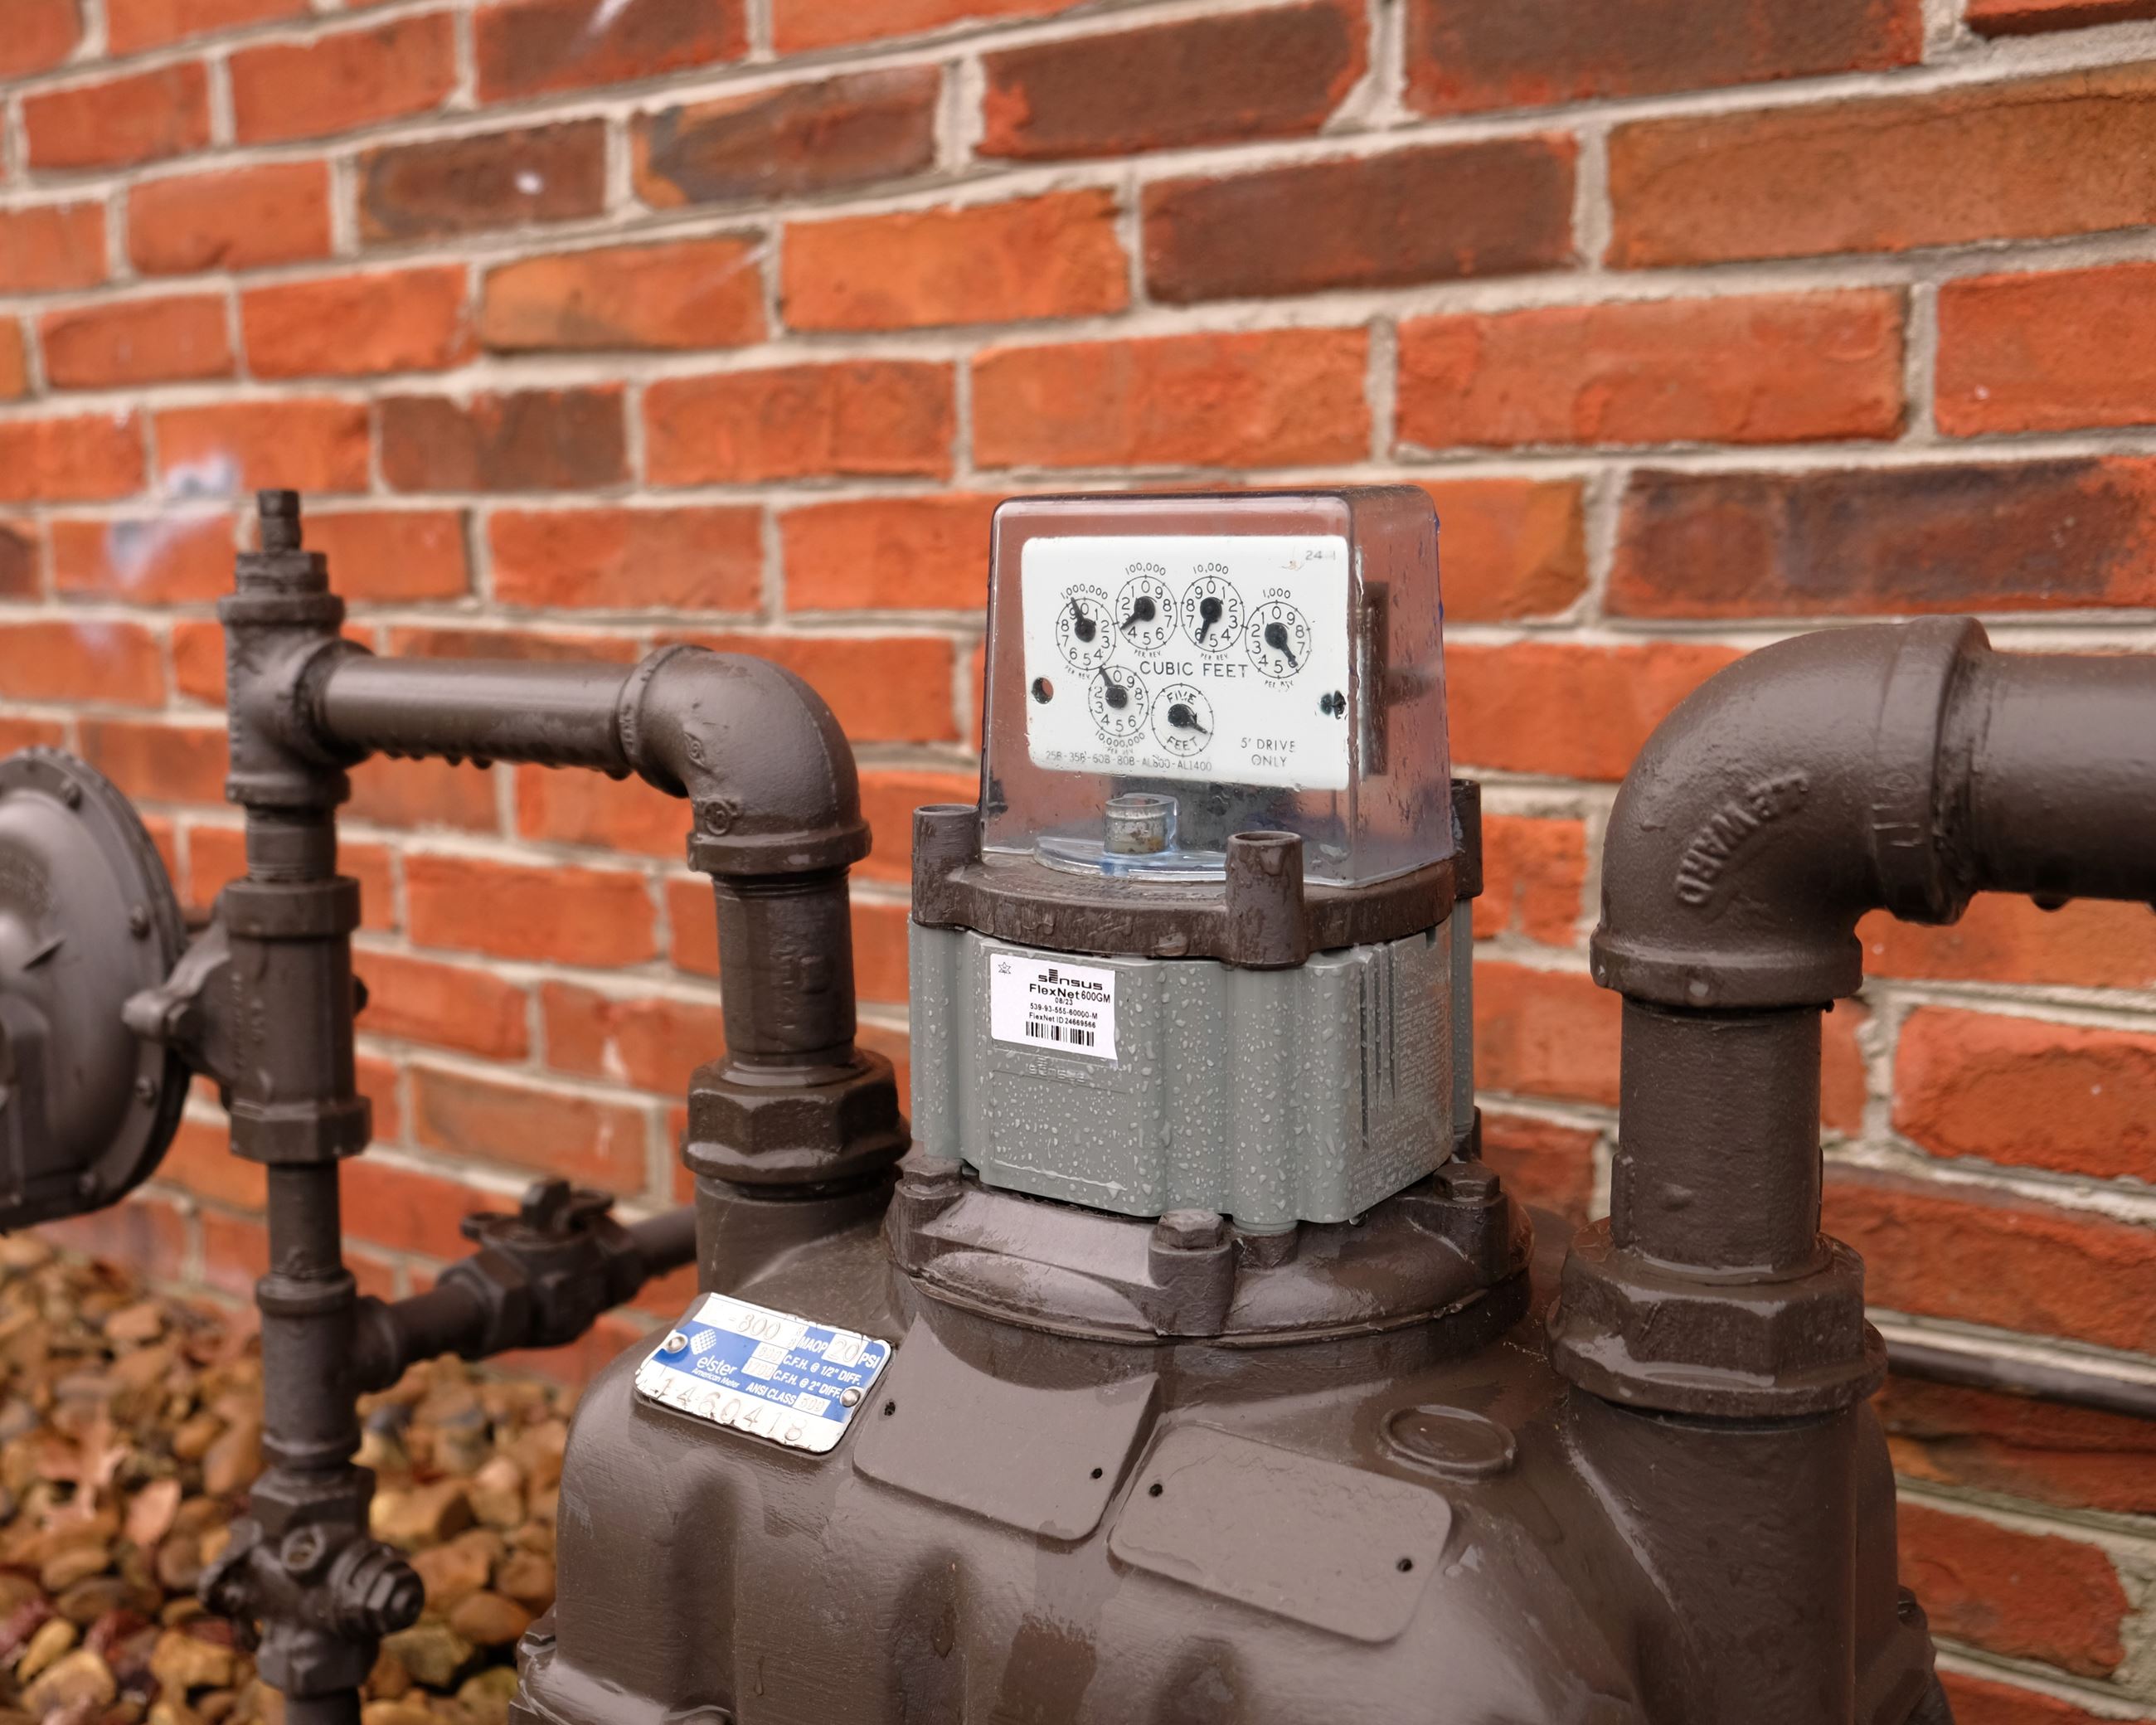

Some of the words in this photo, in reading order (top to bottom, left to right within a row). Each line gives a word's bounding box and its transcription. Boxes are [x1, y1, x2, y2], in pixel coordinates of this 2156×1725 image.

[1125, 562, 1166, 576] 100,000
[1192, 563, 1229, 575] 10,000
[1061, 583, 1108, 600] 1,000,000
[1141, 580, 1150, 593] 0
[1154, 586, 1163, 599] 9
[1195, 586, 1203, 599] 9
[1207, 581, 1216, 594] 0
[1263, 588, 1290, 599] 1,000
[1080, 603, 1089, 615] 0
[1122, 597, 1130, 610] 2
[1163, 599, 1172, 612] 8
[1186, 599, 1195, 612] 8
[1228, 599, 1238, 612] 2
[1272, 606, 1281, 620] 0
[1286, 612, 1295, 625] 9
[1061, 620, 1069, 632] 8
[1101, 620, 1110, 633] 2
[1164, 615, 1173, 628] 7
[1187, 615, 1194, 629] 7
[1228, 615, 1238, 629] 3
[1128, 626, 1138, 639] 4
[1156, 627, 1164, 640] 6
[1221, 629, 1231, 641] 4
[1251, 624, 1260, 637] 2
[1295, 624, 1304, 639] 8
[1061, 635, 1069, 647] 7
[1101, 636, 1110, 649] 3
[1143, 632, 1151, 645] 5
[1209, 634, 1218, 648] 5
[1070, 647, 1077, 660] 6
[1252, 640, 1261, 654] 3
[1297, 642, 1305, 655] 7
[1083, 654, 1091, 666] 5
[1094, 649, 1103, 660] 4
[1259, 654, 1269, 667] 4
[1139, 661, 1193, 676] CUBIC
[1203, 663, 1248, 678] FEET
[1274, 660, 1283, 673] 5
[1113, 669, 1122, 683] 0
[1126, 676, 1134, 688] 9
[1094, 686, 1103, 699] 2
[1134, 688, 1143, 701] 8
[1166, 690, 1197, 705] FIVE
[1095, 702, 1103, 713] 3
[1136, 703, 1144, 716] 7
[1101, 714, 1110, 725] 4
[1115, 720, 1124, 732] 5
[1128, 715, 1136, 727] 6
[1095, 731, 1145, 747] 10,000,000
[1166, 736, 1198, 751] FEET
[1257, 738, 1295, 753] DRIVE
[1251, 753, 1288, 768] ONLY
[1029, 983, 1080, 1000] FlexNet
[1081, 990, 1110, 1003] 600GM
[1029, 1012, 1055, 1023] FlexNet
[797, 1336, 829, 1353] MAOP
[827, 1339, 860, 1363] 20
[857, 1353, 881, 1368] PSI
[697, 1355, 738, 1376] elster
[783, 1354, 807, 1370] C.F.H.
[810, 1363, 820, 1373] @
[838, 1369, 862, 1386] DIFF.
[691, 1368, 721, 1383] American
[721, 1378, 741, 1388] Meter
[773, 1369, 797, 1386] C.F.H.
[799, 1378, 809, 1388] @
[818, 1383, 842, 1399] DIFF.
[746, 1382, 769, 1396] ANSI
[767, 1388, 798, 1405] CLASS
